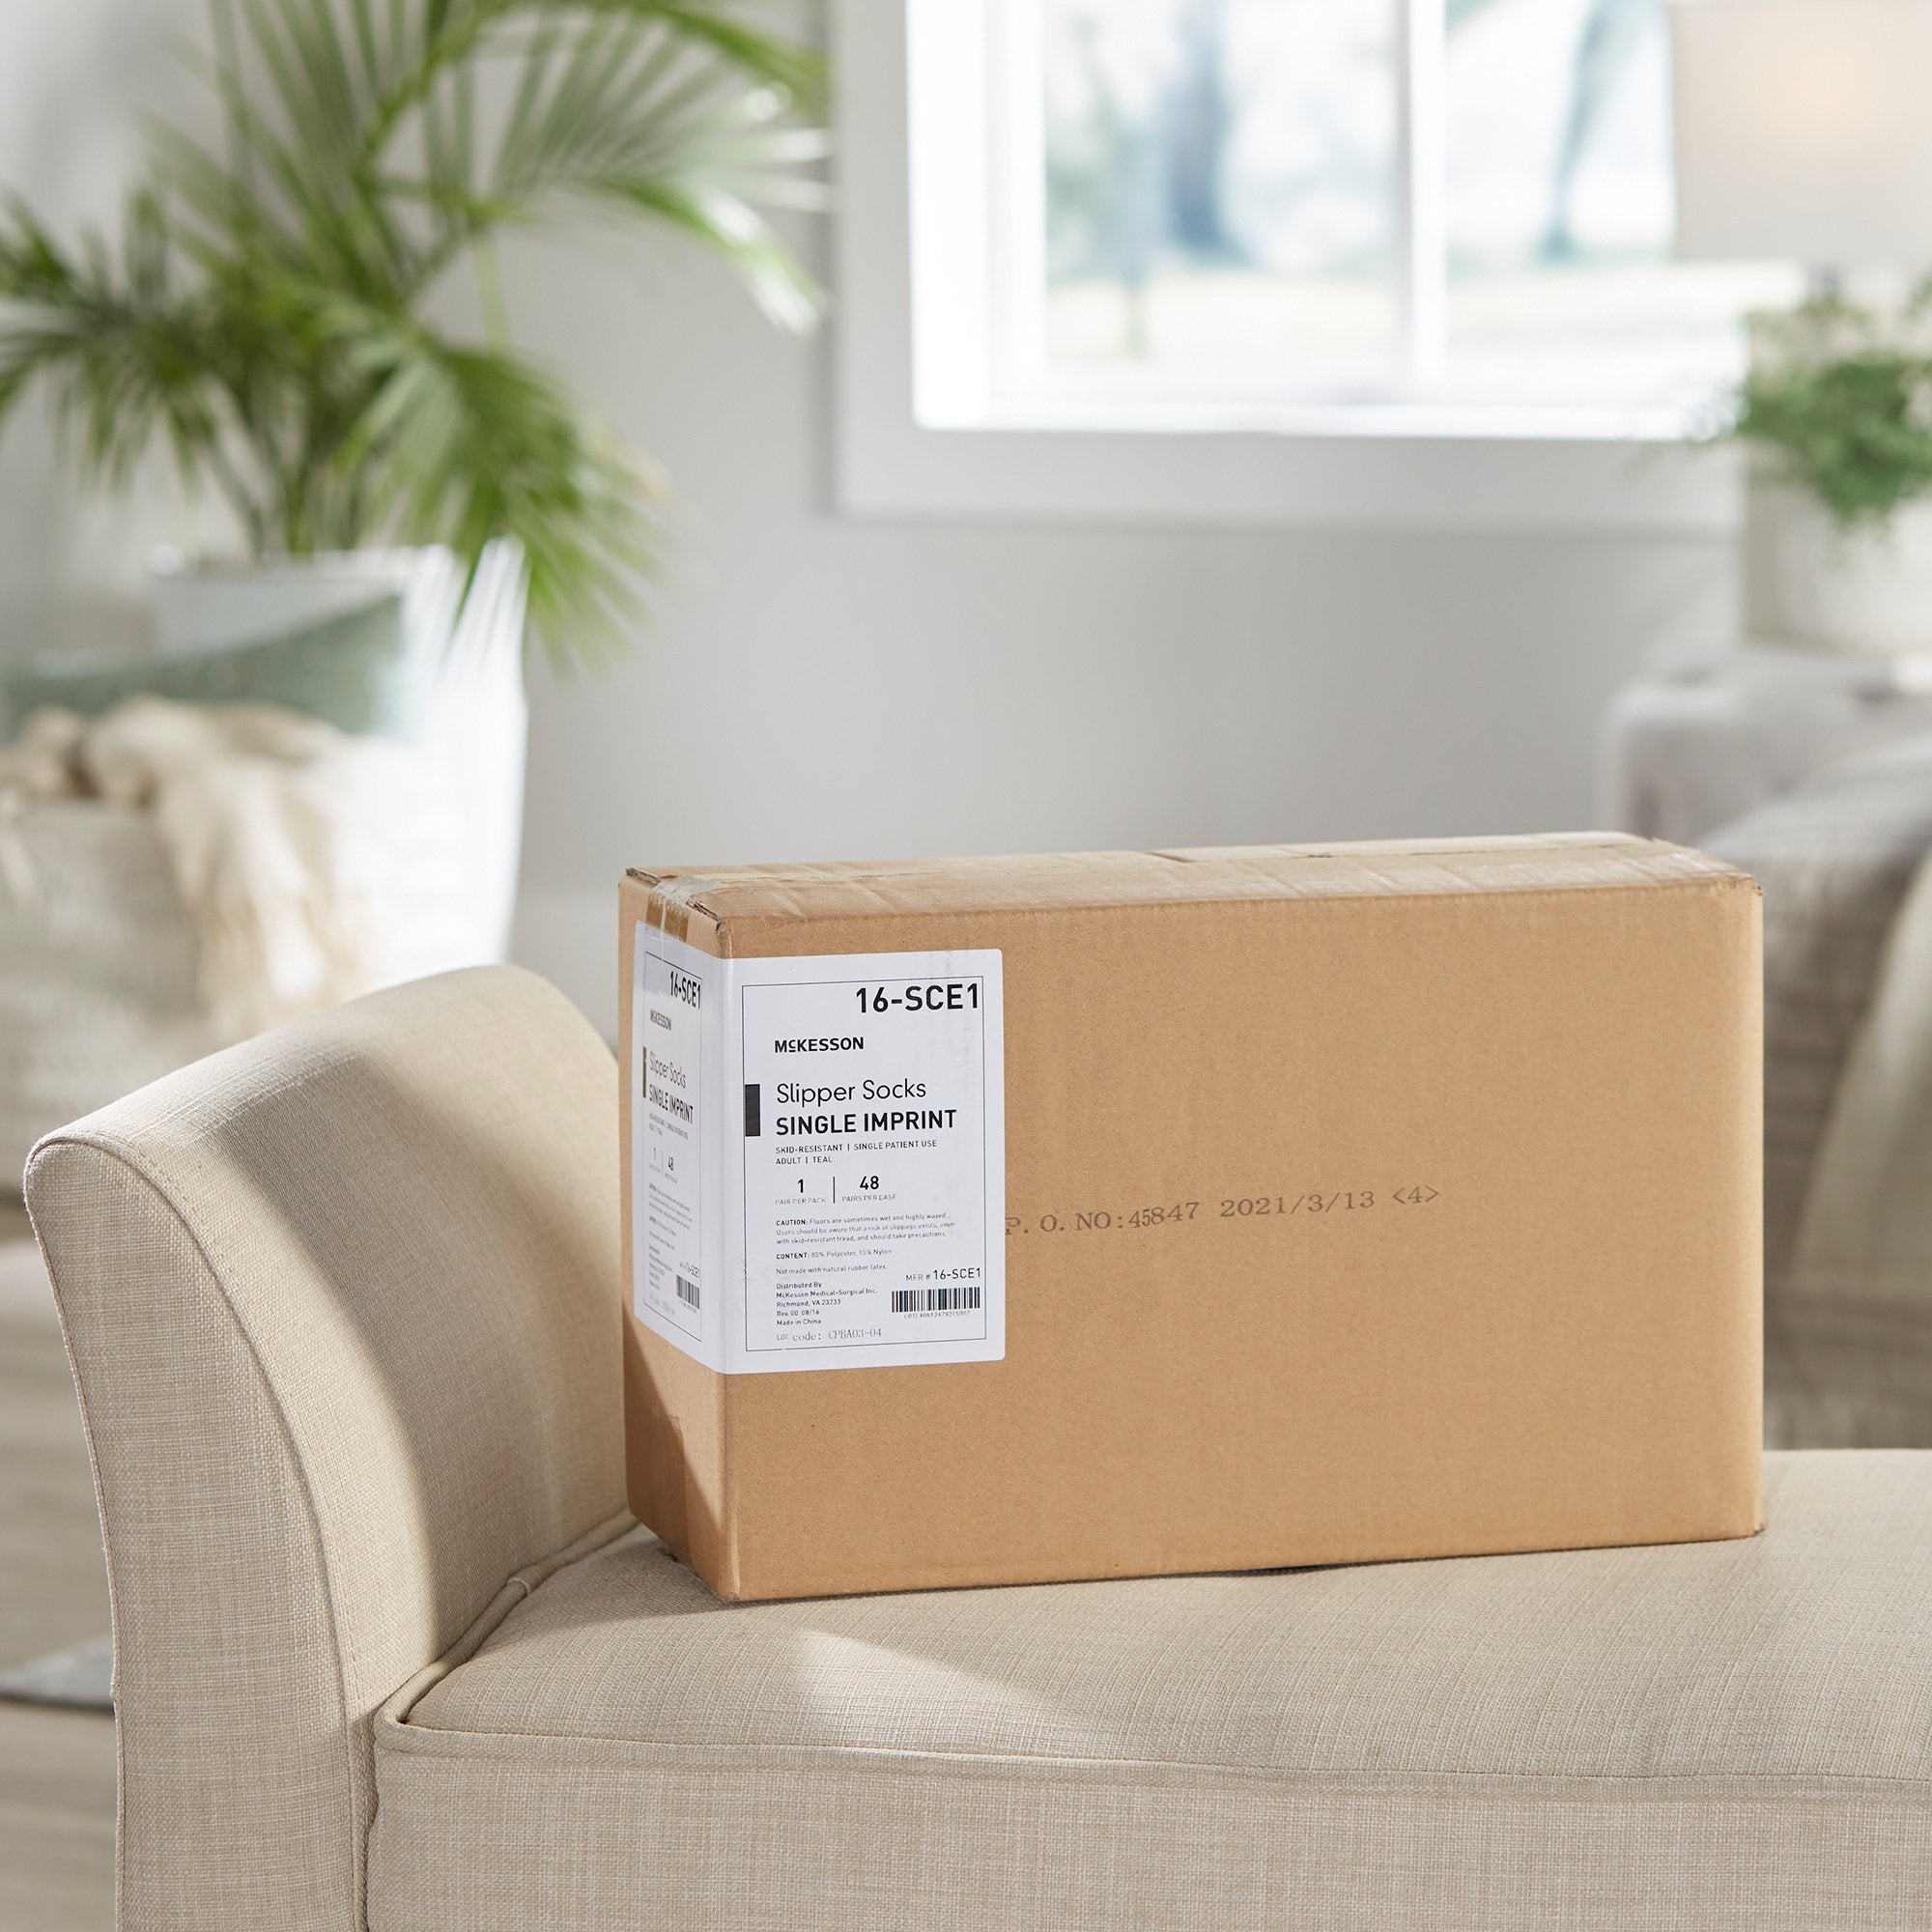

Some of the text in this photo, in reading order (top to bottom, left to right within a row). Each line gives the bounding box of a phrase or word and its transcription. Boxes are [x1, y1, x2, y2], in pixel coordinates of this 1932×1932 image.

[856, 983, 979, 1013] 16-SCE1
[776, 1078, 926, 1108] Slipper Socks
[776, 1109, 957, 1136] SINGLE IMPRINT
[776, 1139, 937, 1154] SKID-RESISTANT SINGLE PATIENT USE
[776, 1156, 802, 1165] ADULT
[797, 1179, 804, 1193] 1
[859, 1175, 880, 1190] 48
[1220, 1189, 1375, 1218] 2021/3/13
[1393, 1185, 1439, 1205] <4>
[933, 1267, 980, 1280] 16-SCE1
[810, 1289, 865, 1297] Medical-Surgical
[792, 1331, 822, 1342] code:
